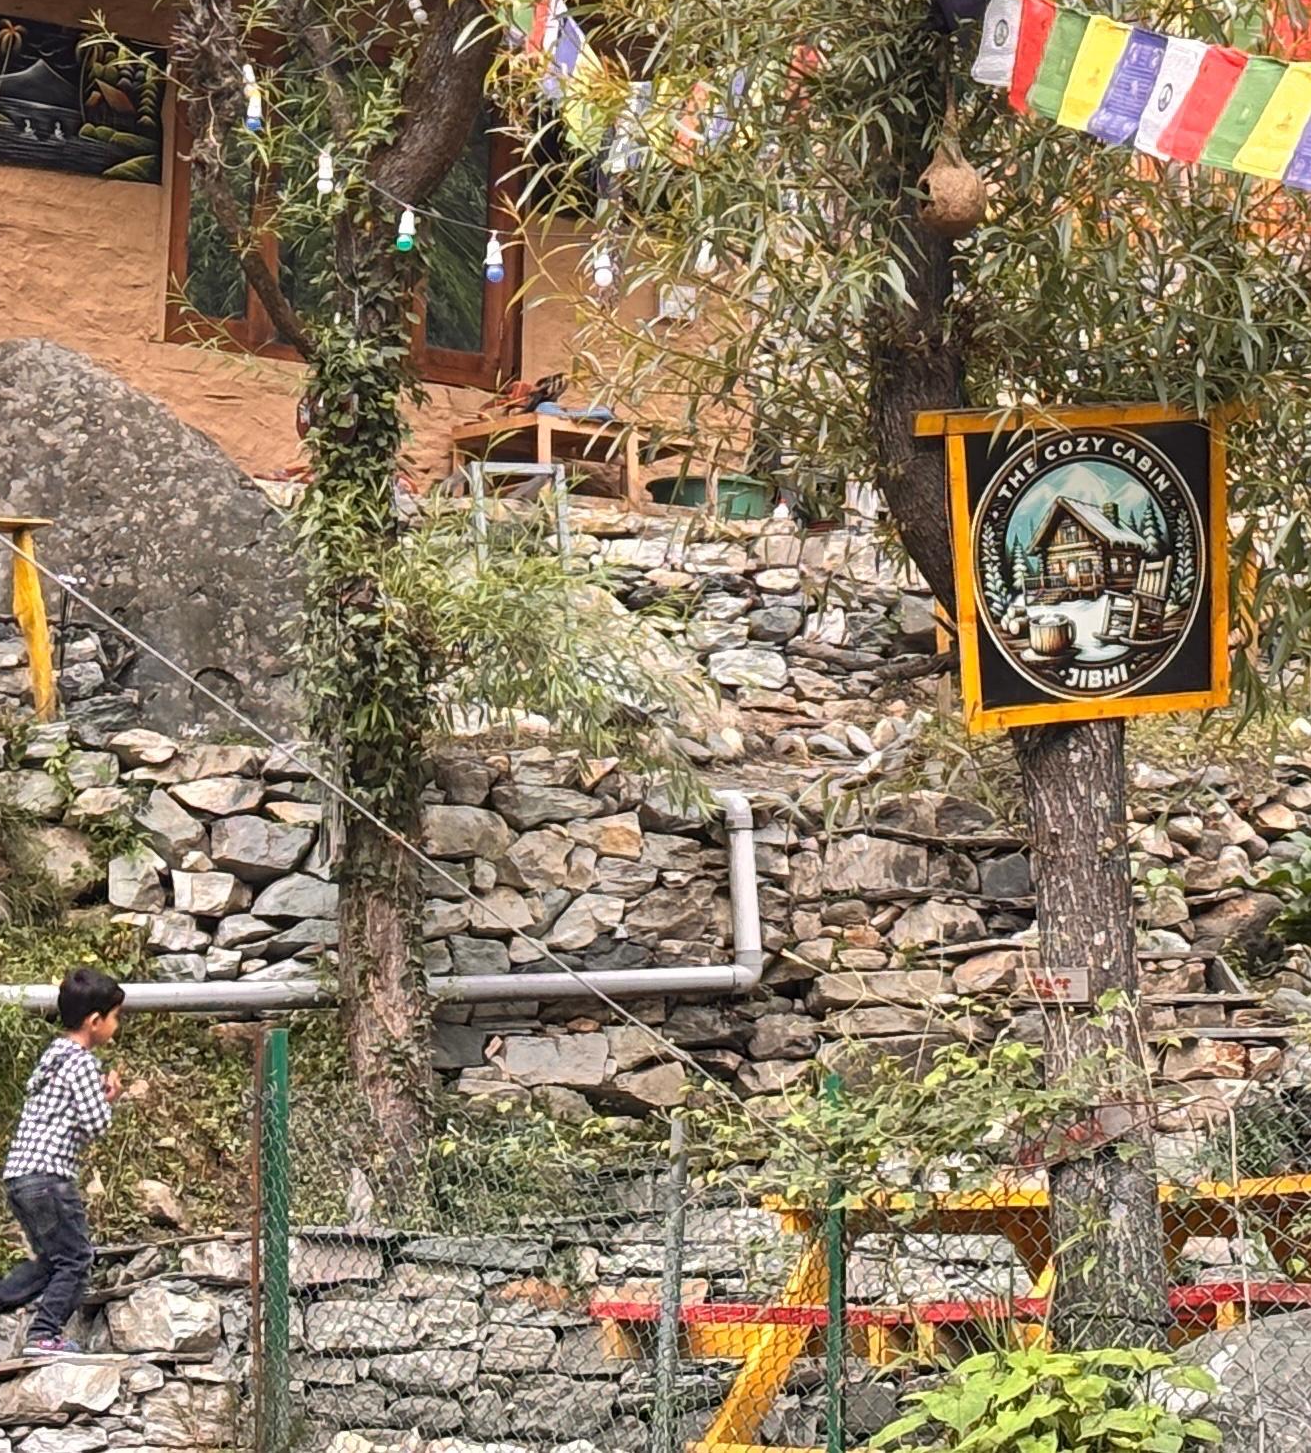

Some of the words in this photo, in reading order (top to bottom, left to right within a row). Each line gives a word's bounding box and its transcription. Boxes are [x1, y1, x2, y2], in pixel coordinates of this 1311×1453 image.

[998, 456, 1037, 501] THE
[1044, 436, 1106, 461] COZY
[1112, 440, 1171, 493] CABIN
[1065, 663, 1128, 689] JIBHI
